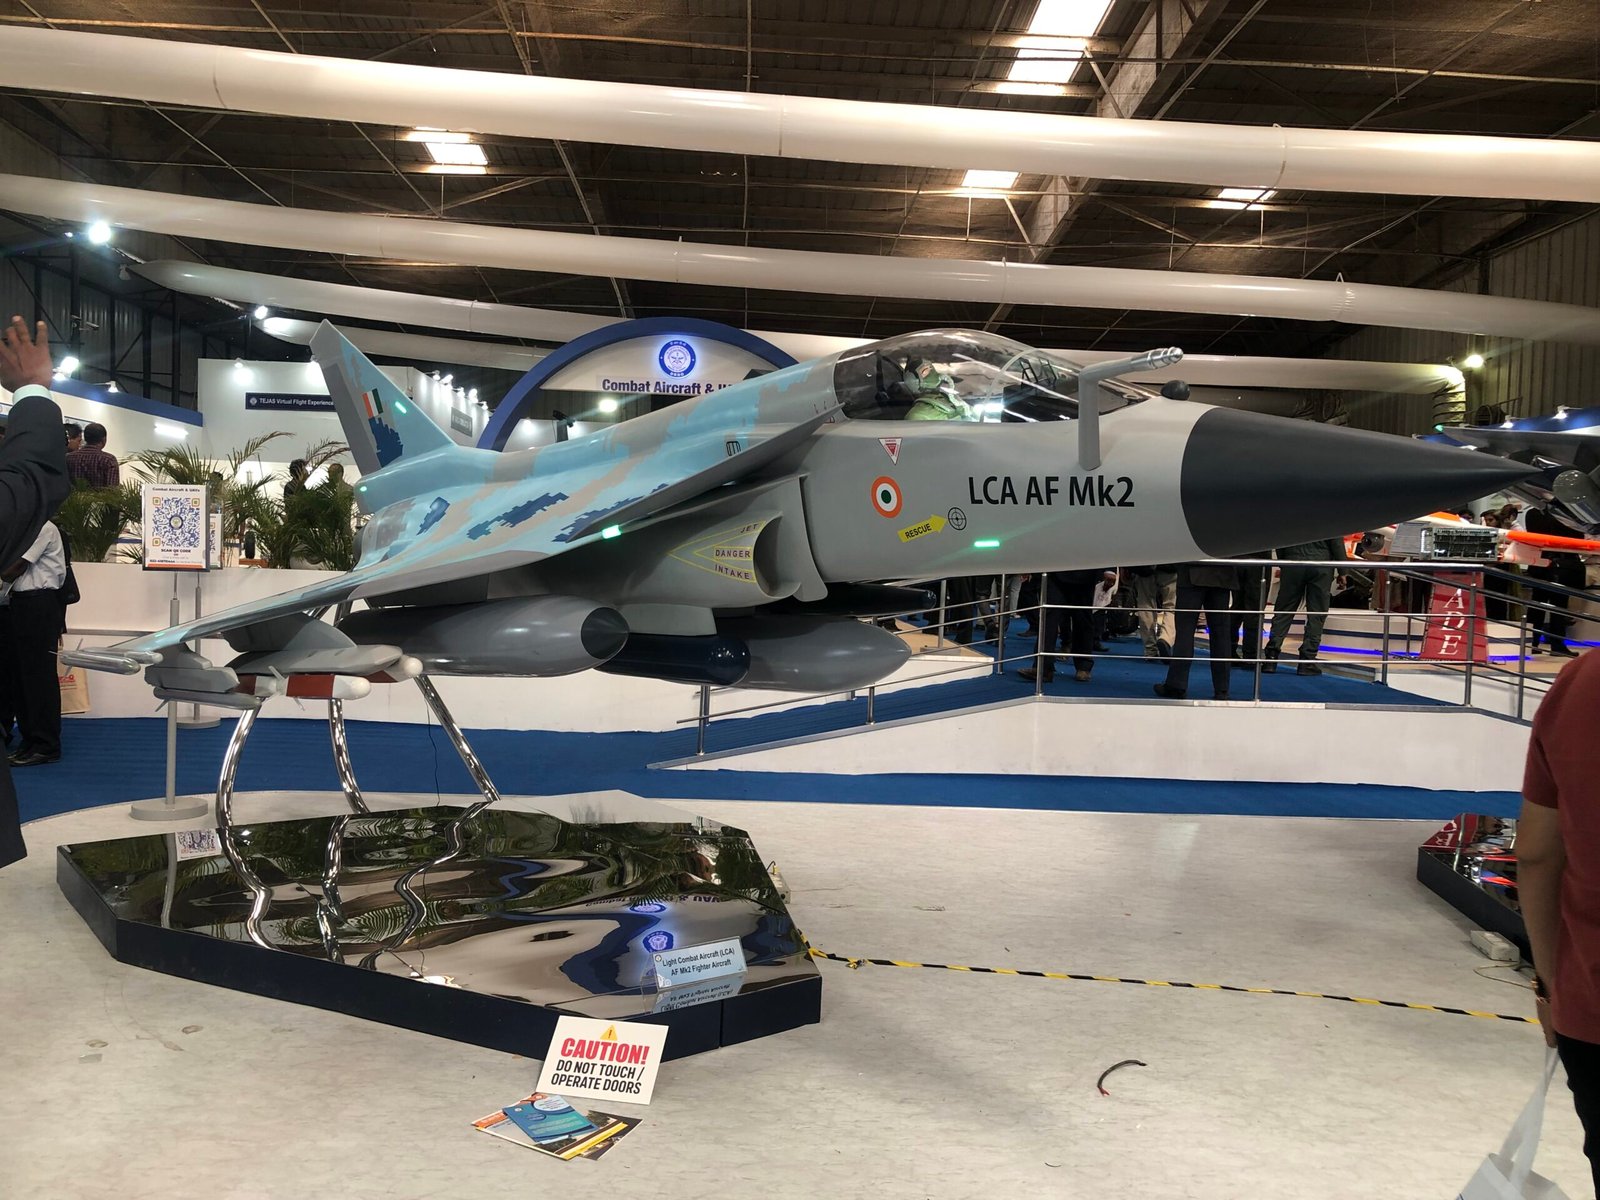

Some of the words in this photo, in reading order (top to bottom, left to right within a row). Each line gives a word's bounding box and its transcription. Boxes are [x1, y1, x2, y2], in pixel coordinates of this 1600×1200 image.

[602, 379, 651, 393] Combat
[653, 381, 702, 395] Aircraft
[704, 383, 715, 394] &
[968, 476, 1018, 505] LCA
[1025, 476, 1059, 506] AF
[1069, 475, 1135, 507] Mk2
[740, 523, 758, 534] JET
[904, 523, 932, 539] RESCUE
[715, 549, 751, 558] DANGER
[715, 564, 750, 580] INTAKE
[662, 959, 678, 968] Light
[677, 955, 699, 964] Combat
[699, 950, 719, 959] Aircraft
[719, 948, 735, 957] (LCA)
[671, 969, 679, 977] AF
[680, 966, 691, 974] Mk2
[692, 963, 711, 973] Fighter
[711, 960, 732, 968] Aircraft
[561, 1037, 650, 1065] CAUTION!
[556, 1059, 573, 1073] DO
[573, 1061, 597, 1075] NOT
[599, 1063, 636, 1080] TOUCH
[636, 1066, 645, 1081] /
[551, 1073, 602, 1090] OPERATE
[602, 1079, 642, 1094] DOORS
